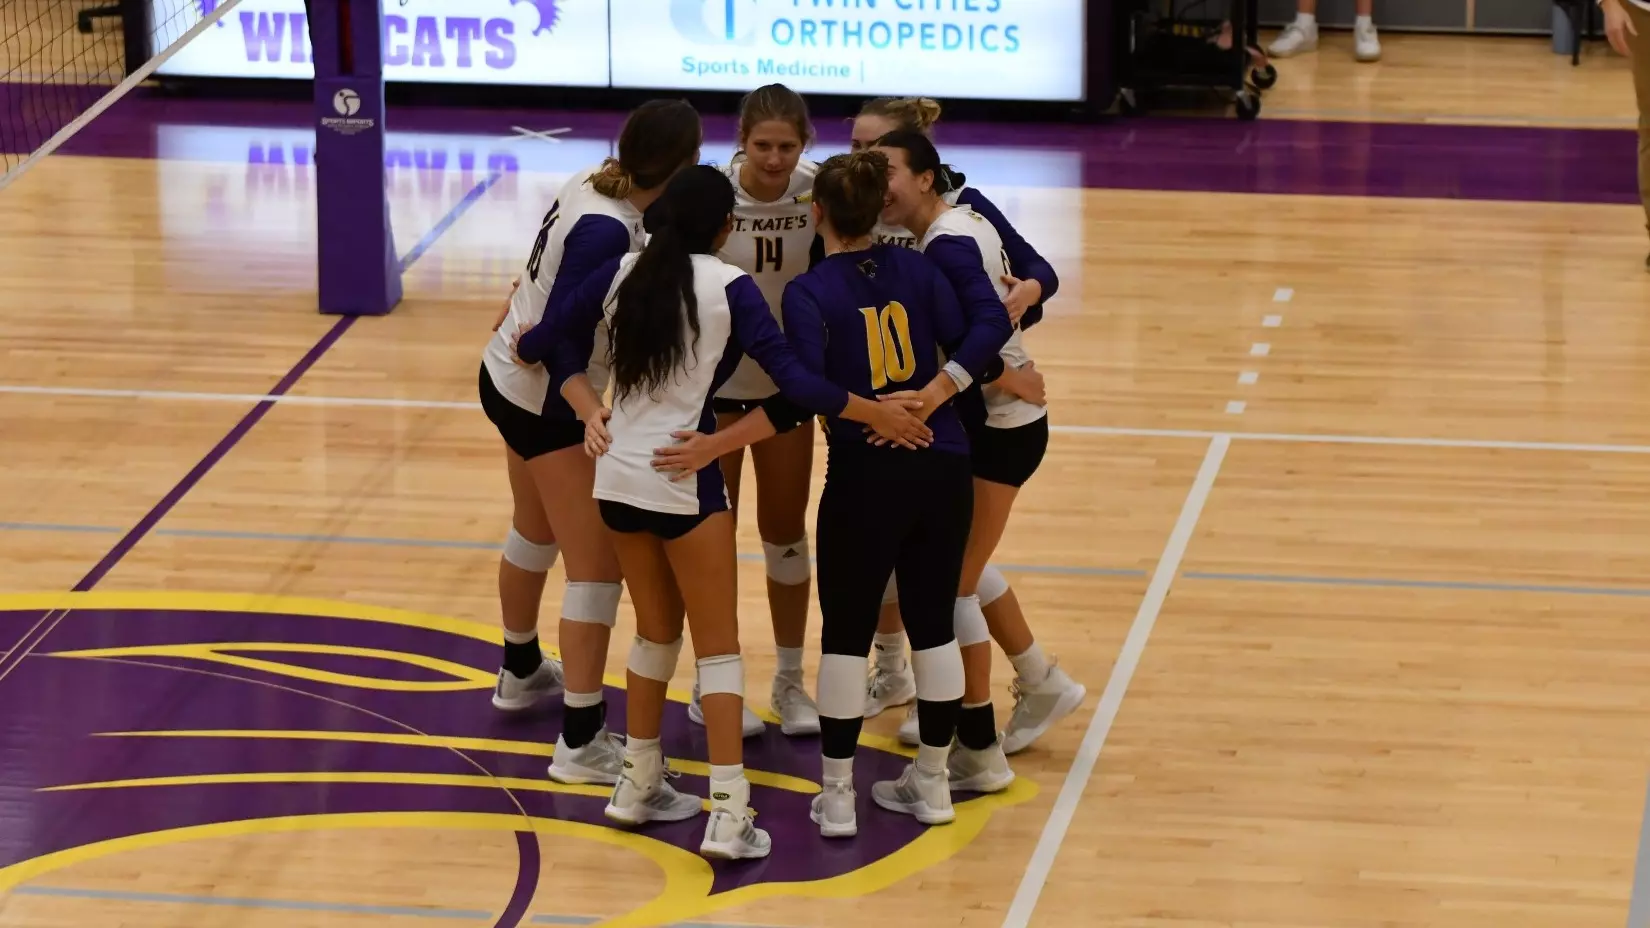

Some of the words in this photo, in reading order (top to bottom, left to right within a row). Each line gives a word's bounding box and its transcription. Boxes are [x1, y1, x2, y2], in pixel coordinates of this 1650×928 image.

[239, 11, 517, 70] WICATS
[771, 18, 1020, 51] ORTHOPEDICS
[681, 56, 750, 76] Sports
[757, 58, 850, 78] Medicine
[752, 214, 808, 232] KATE'S
[753, 236, 783, 273] 14
[858, 300, 917, 390] 10
